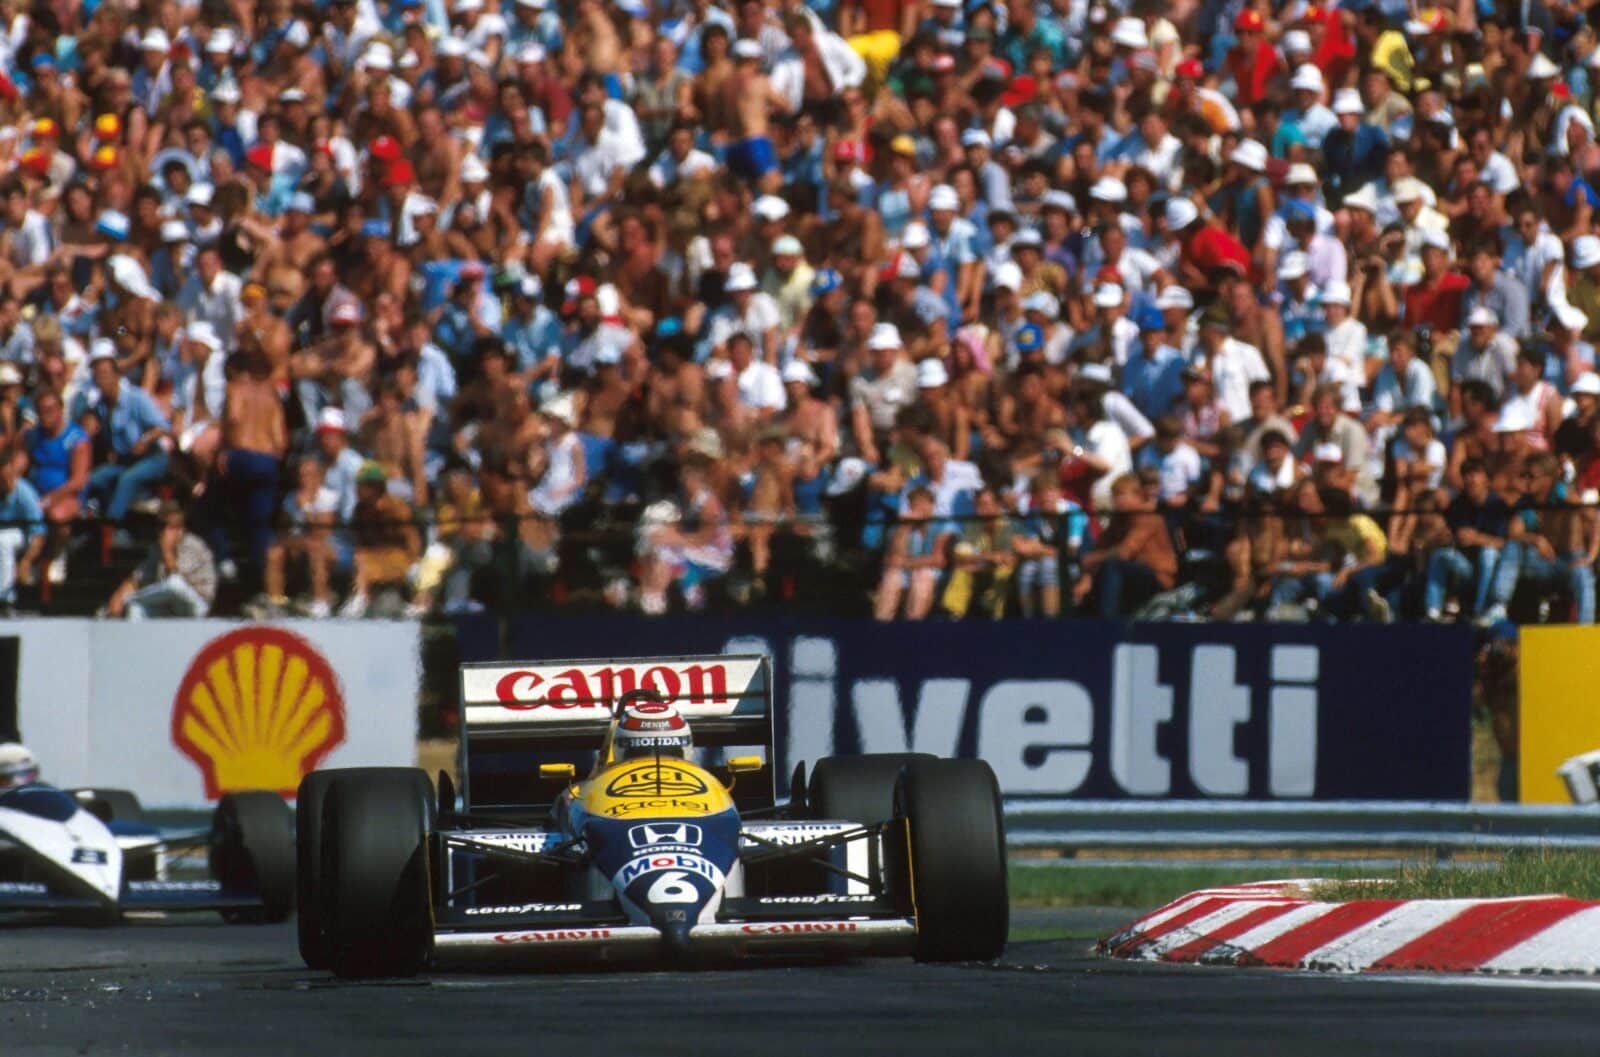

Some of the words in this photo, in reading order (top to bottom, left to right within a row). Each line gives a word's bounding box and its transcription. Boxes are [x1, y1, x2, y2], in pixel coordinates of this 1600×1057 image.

[495, 664, 728, 711] Canon
[630, 770, 682, 783] ICI
[604, 799, 712, 817] Tactel
[632, 845, 703, 856] HONDA
[623, 855, 714, 884] Mobil
[647, 871, 699, 903] 6
[760, 893, 877, 904] GOODYEAR
[465, 903, 583, 915] GOODYEAR
[741, 922, 857, 934] Canon
[494, 930, 611, 944] Canon
